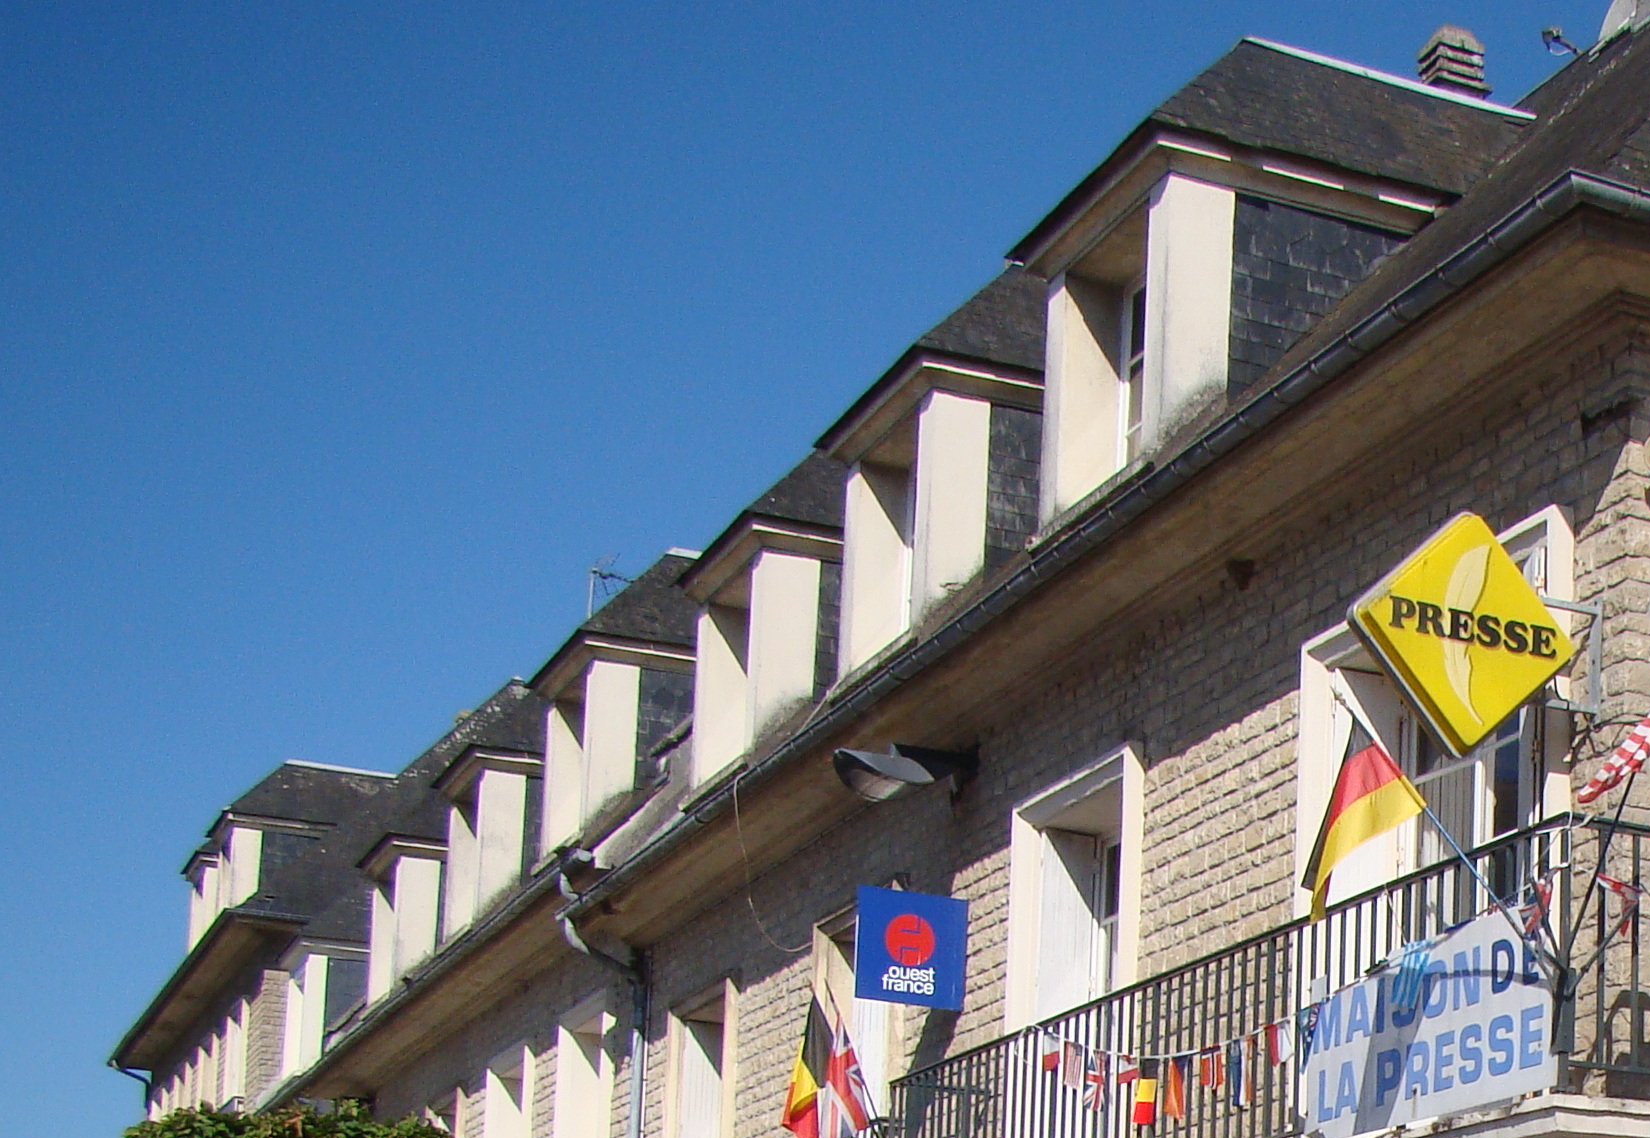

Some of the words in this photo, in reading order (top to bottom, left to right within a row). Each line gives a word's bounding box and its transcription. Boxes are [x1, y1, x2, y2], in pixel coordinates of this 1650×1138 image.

[1389, 595, 1557, 659] PRESSE
[882, 974, 934, 995] france
[888, 966, 935, 982] ouest
[1317, 1061, 1358, 1123] LA
[1376, 1004, 1544, 1107] PRESSE
